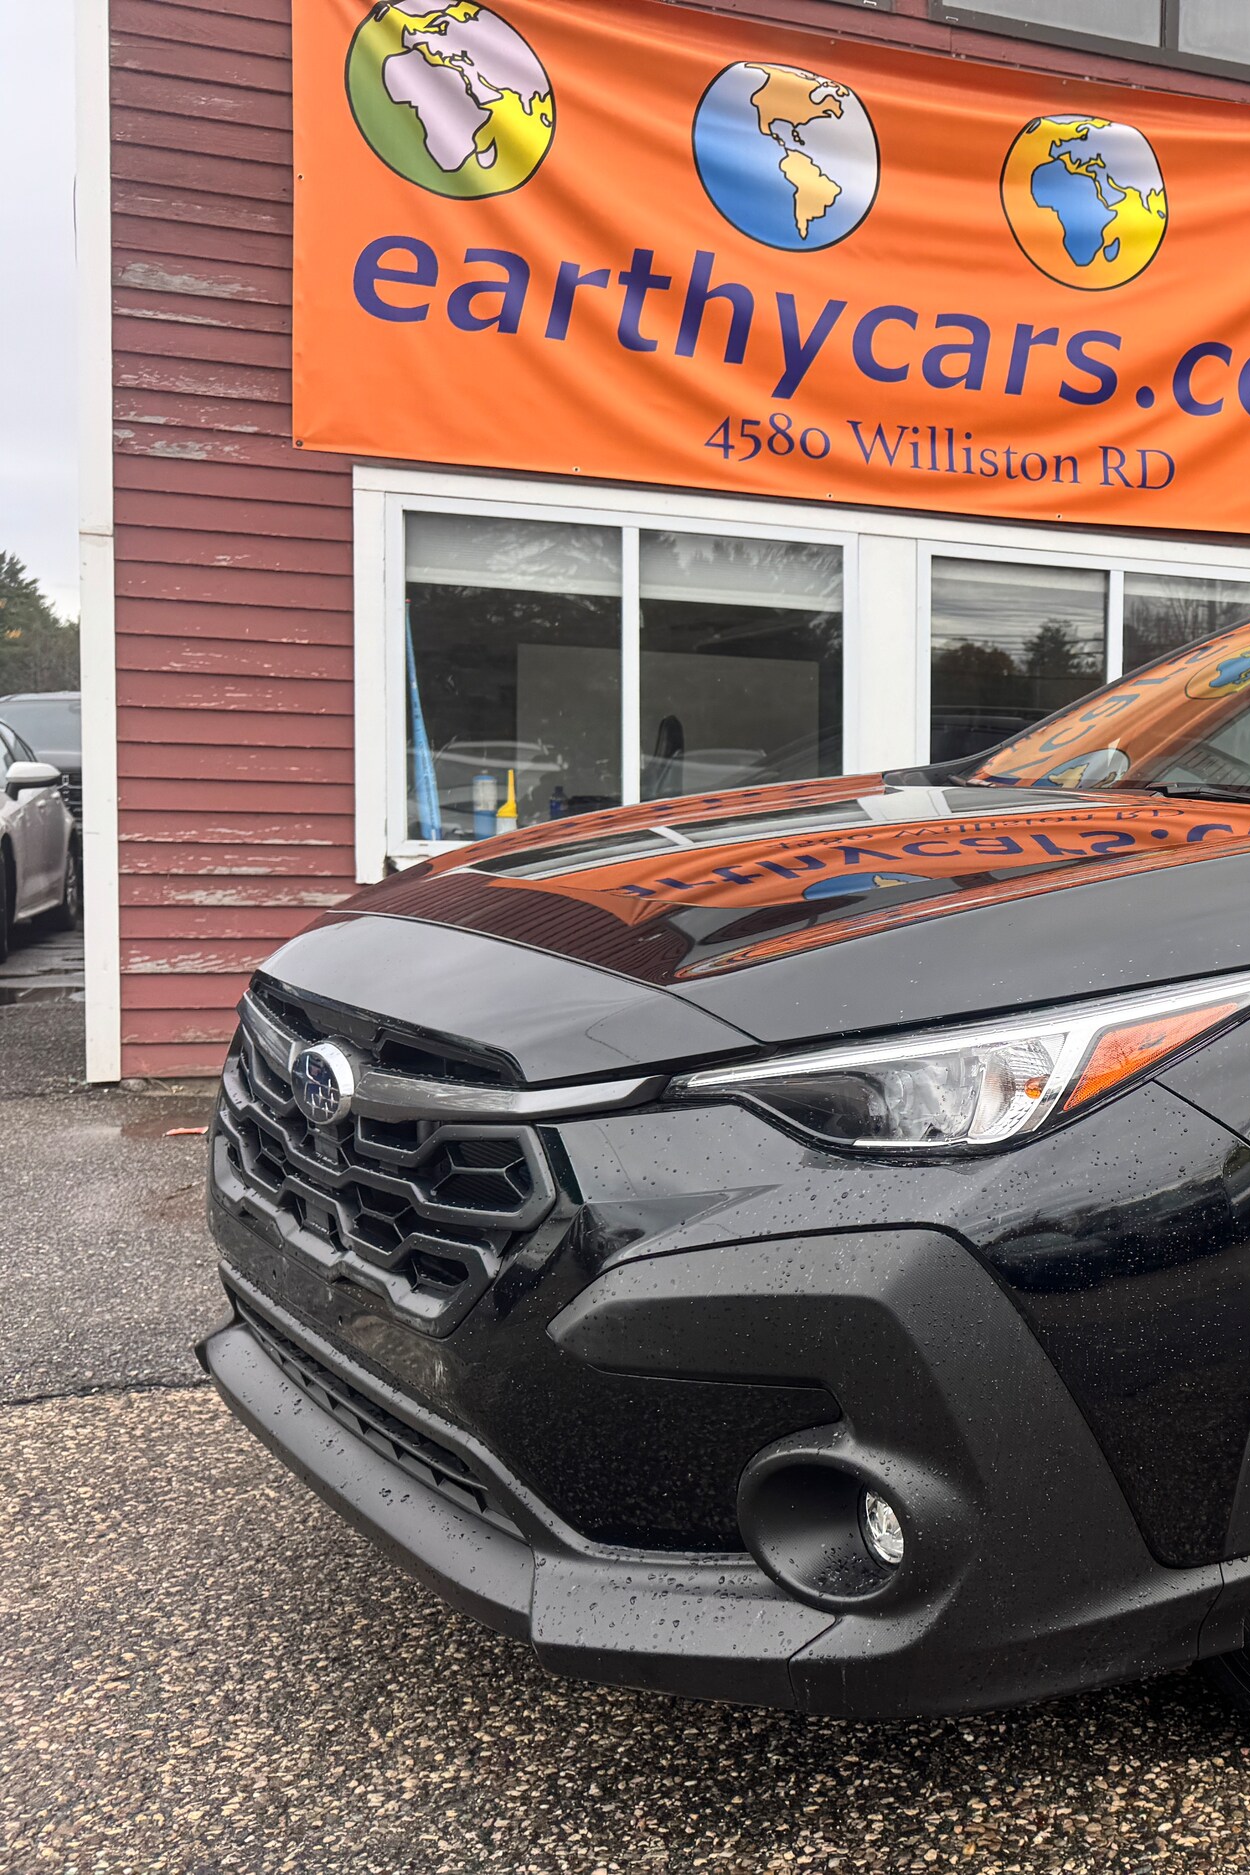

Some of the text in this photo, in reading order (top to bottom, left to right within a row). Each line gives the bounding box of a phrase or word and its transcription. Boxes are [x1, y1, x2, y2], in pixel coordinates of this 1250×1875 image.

[704, 412, 1176, 490] 4580 Williston RD
